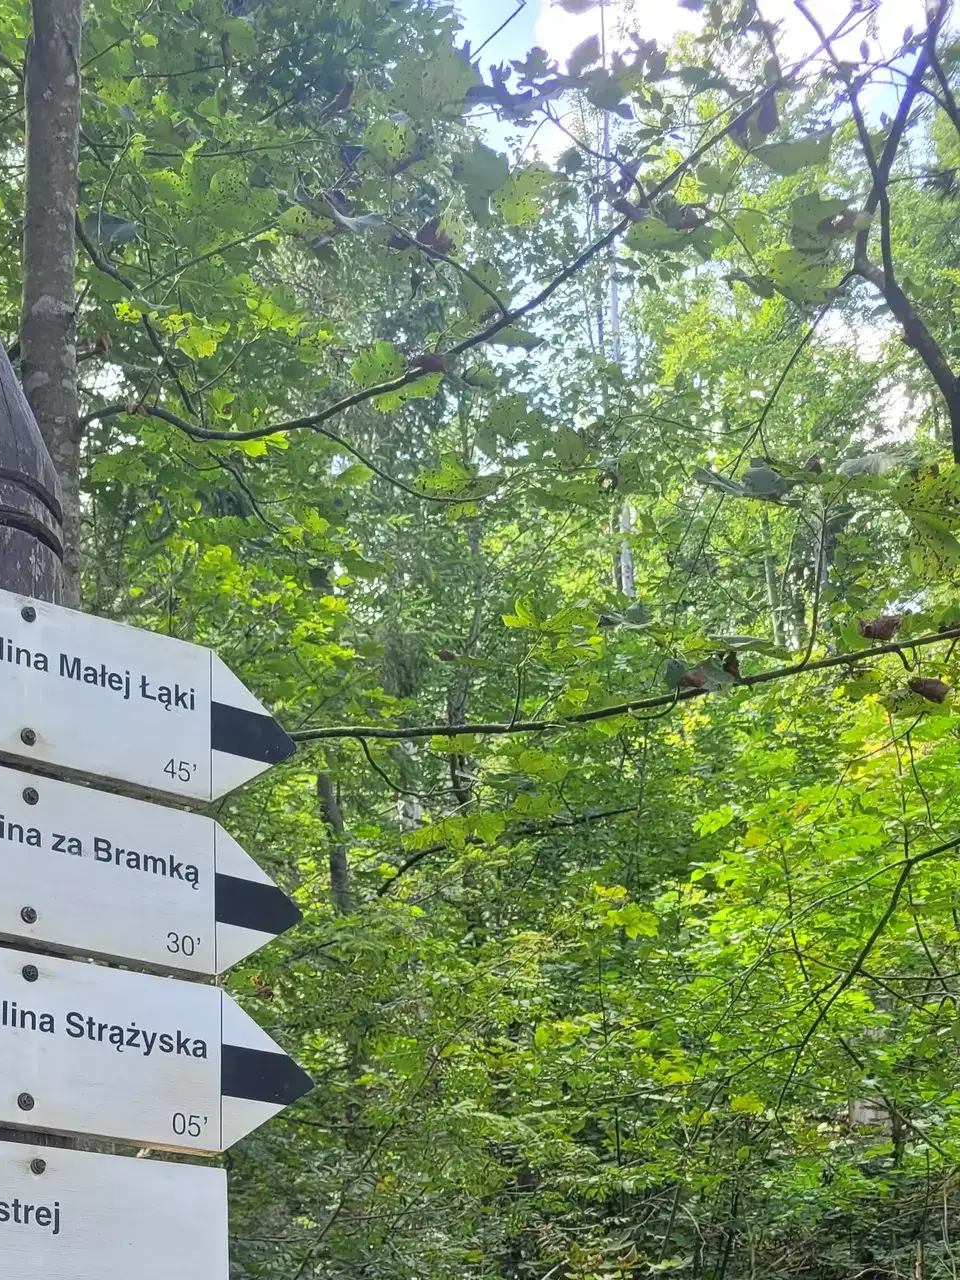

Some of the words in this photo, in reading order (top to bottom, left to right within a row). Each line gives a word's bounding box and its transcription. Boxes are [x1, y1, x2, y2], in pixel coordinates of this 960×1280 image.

[60, 654, 131, 699] Małej
[140, 675, 196, 711] Łąki
[52, 834, 82, 857] za
[94, 837, 200, 890] Bramką
[66, 1011, 208, 1059] Strążyska
